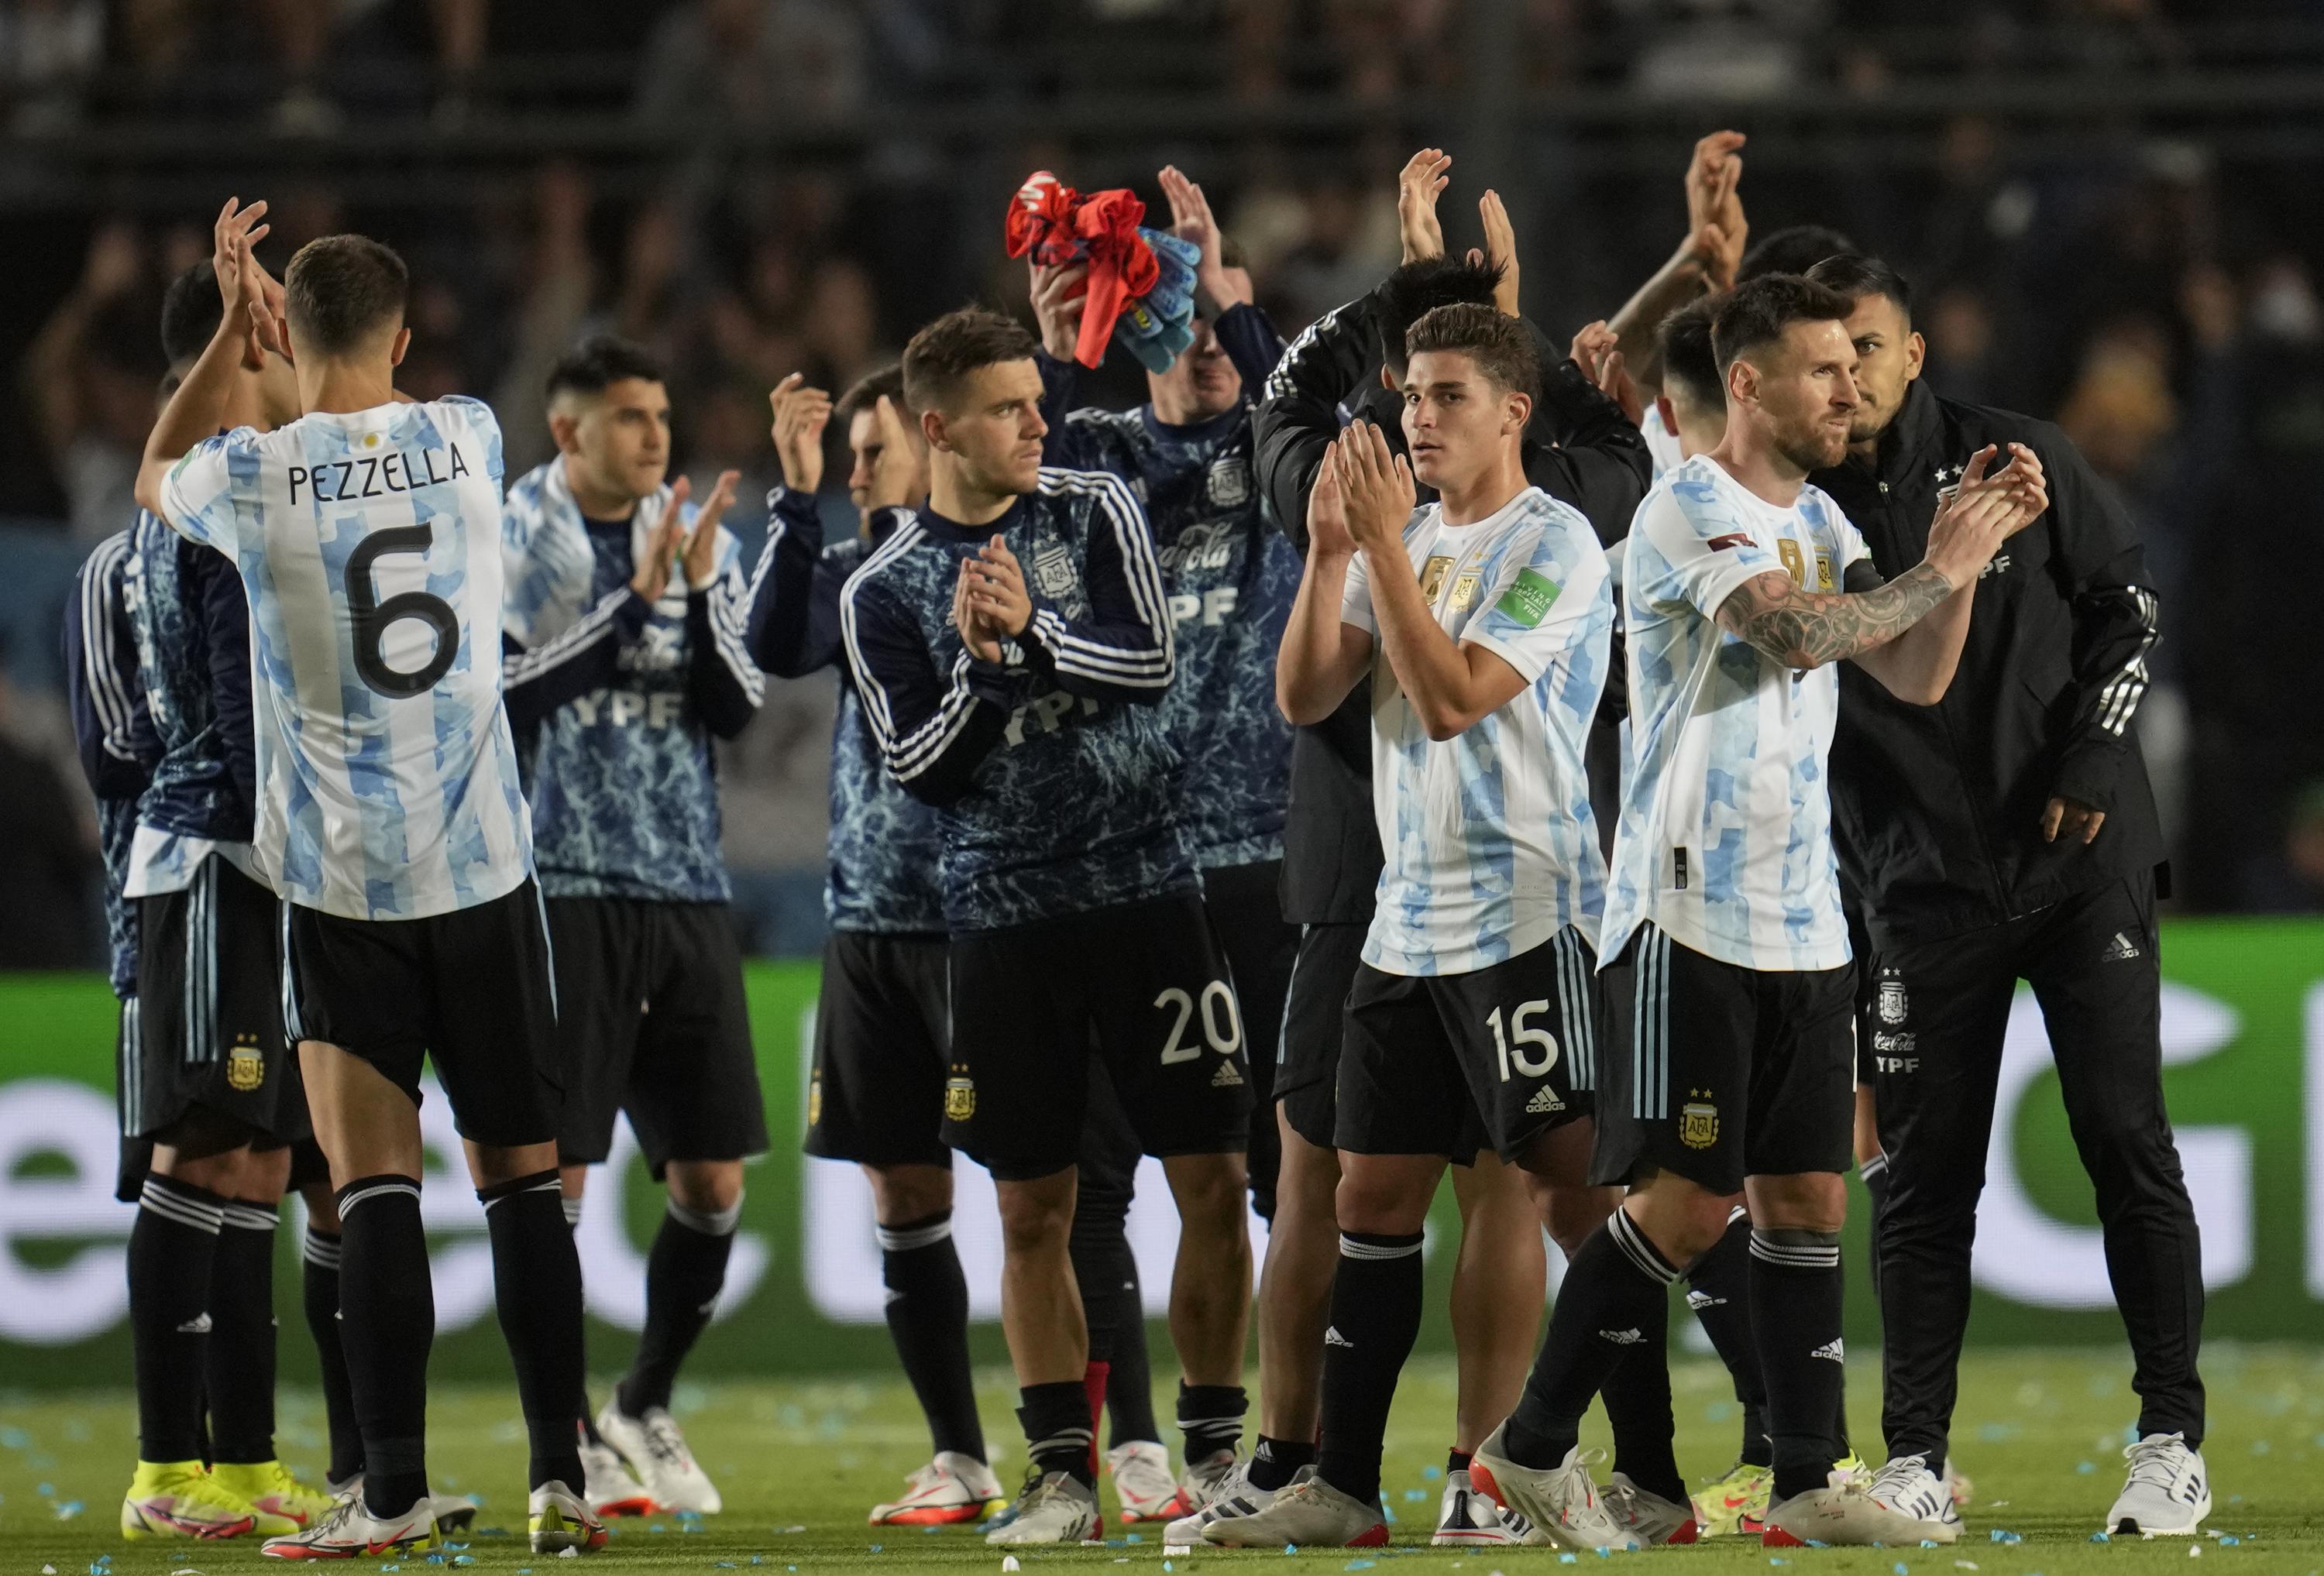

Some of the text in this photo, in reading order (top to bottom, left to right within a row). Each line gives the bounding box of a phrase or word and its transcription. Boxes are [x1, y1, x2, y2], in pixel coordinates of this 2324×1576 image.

[288, 441, 470, 506] PEZZELLA
[1979, 555, 2010, 579] PF
[344, 520, 459, 700] 6
[1167, 586, 1239, 632] PF
[1523, 604, 1540, 620] FIFA
[572, 688, 684, 730] YPF
[1153, 980, 1241, 1065] 20
[1485, 998, 1559, 1083] 15
[1875, 1056, 1920, 1073] YPF
[1525, 1101, 1566, 1114] adidas
